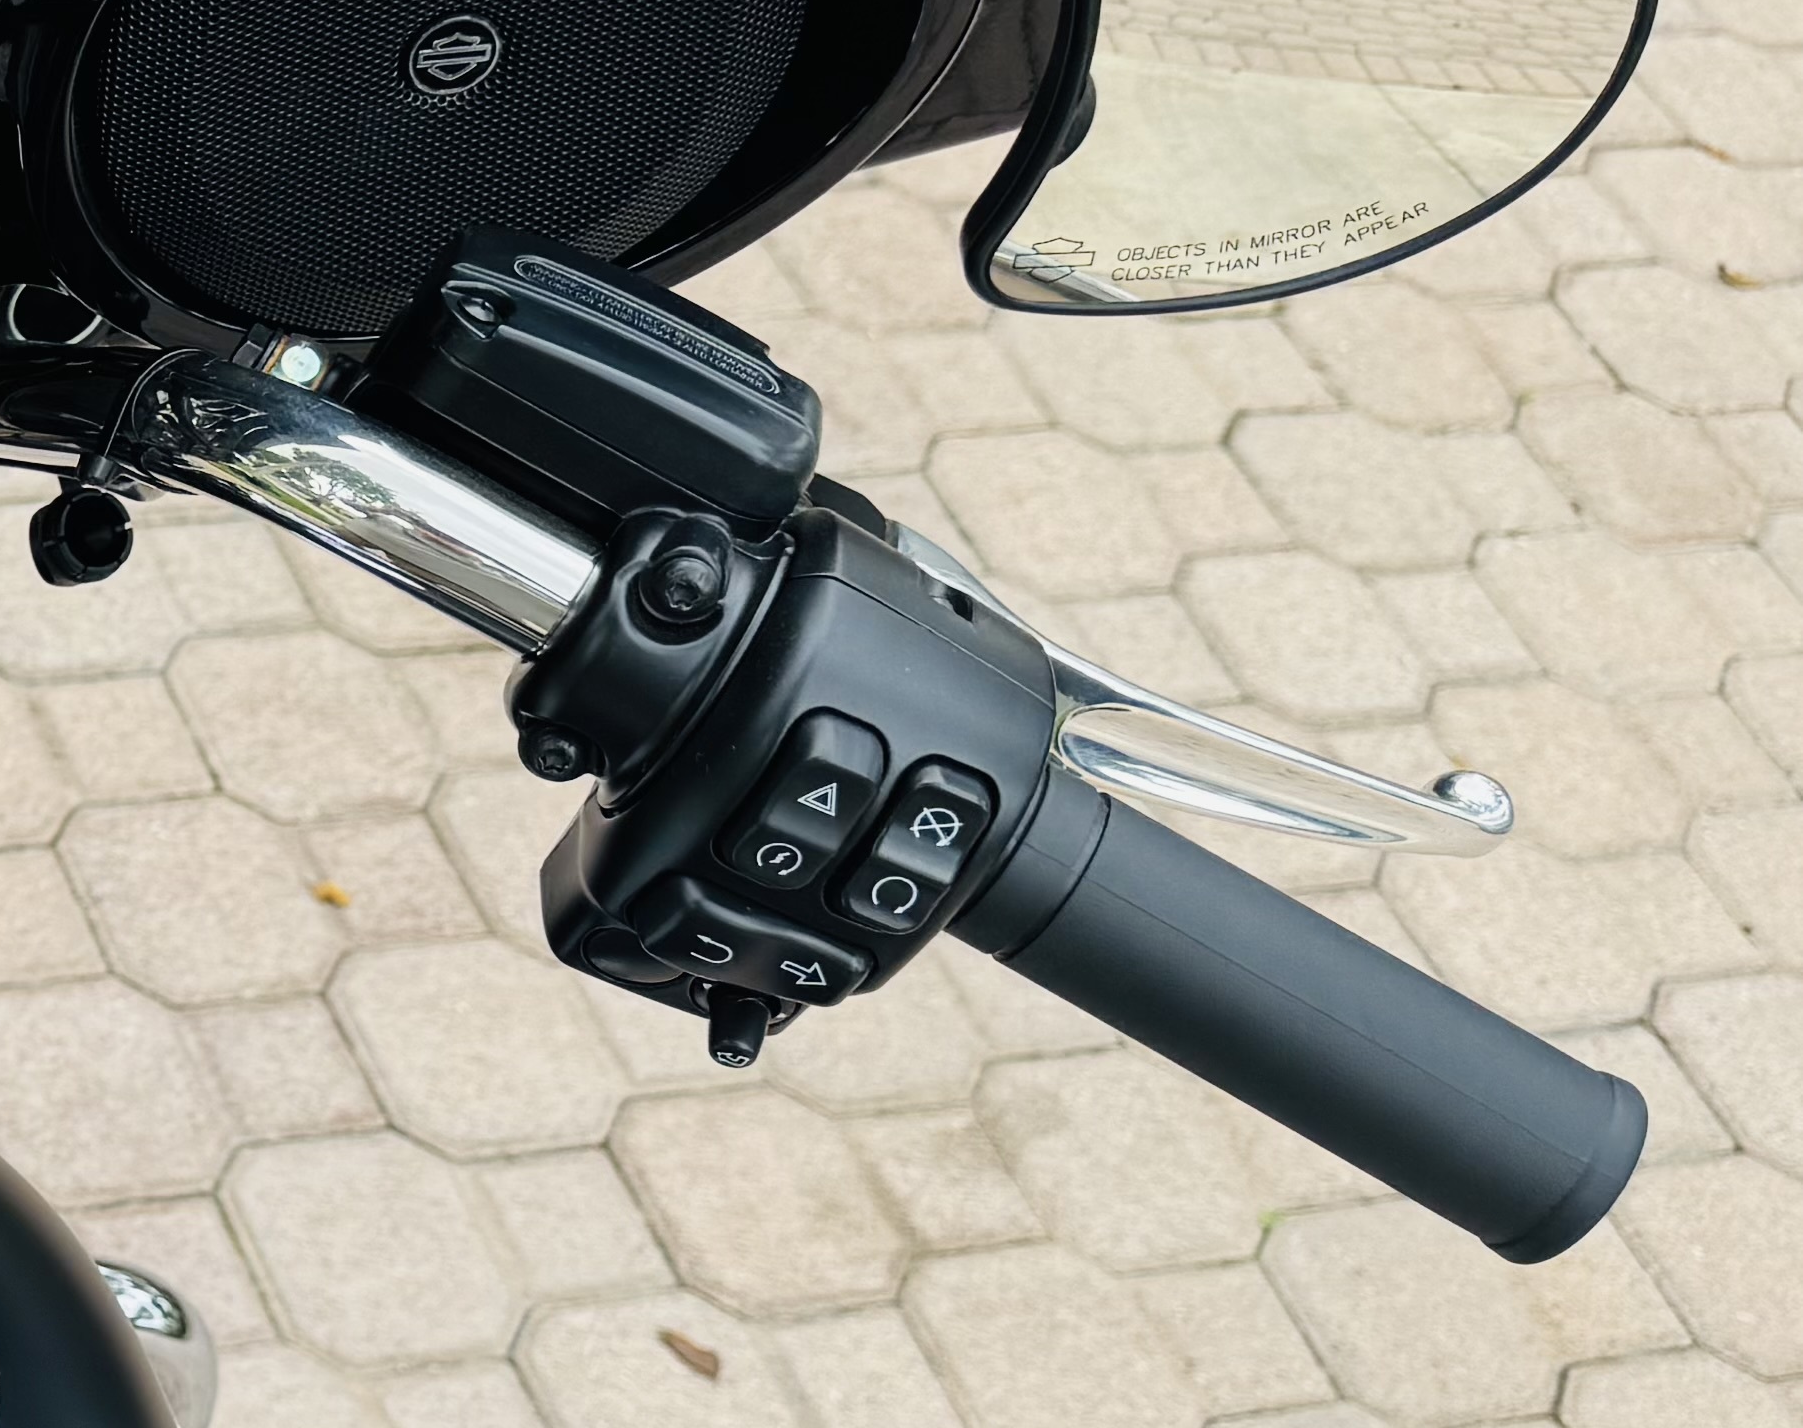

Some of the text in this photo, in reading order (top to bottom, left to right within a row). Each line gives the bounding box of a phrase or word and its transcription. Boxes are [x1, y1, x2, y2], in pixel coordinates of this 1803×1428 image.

[1111, 201, 1431, 283] CLOSER THAN THEY APPEAR
[1117, 200, 1384, 263] OBJECTS IN MIRROR ARE
